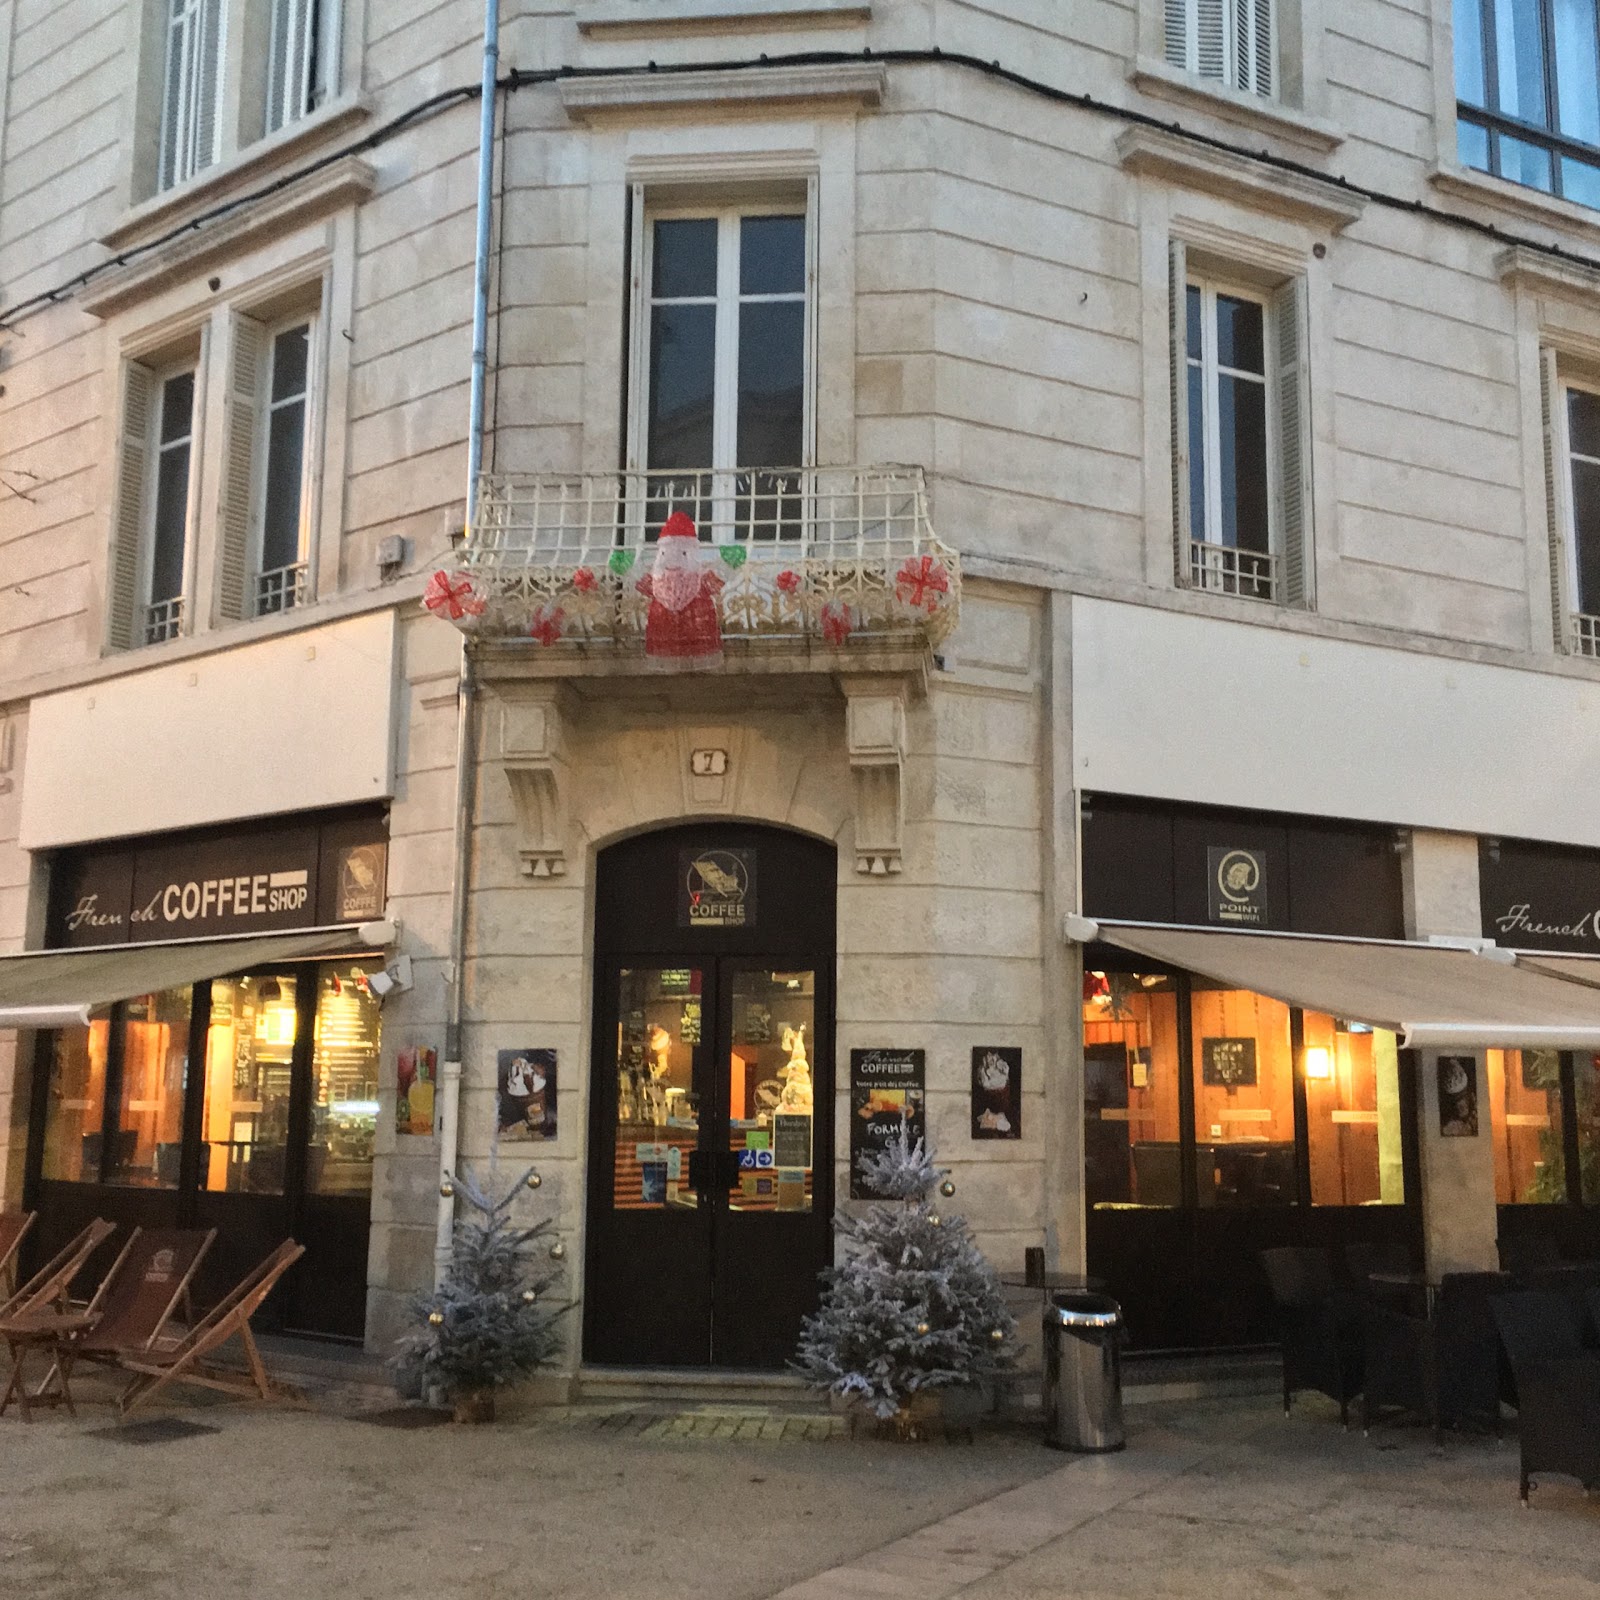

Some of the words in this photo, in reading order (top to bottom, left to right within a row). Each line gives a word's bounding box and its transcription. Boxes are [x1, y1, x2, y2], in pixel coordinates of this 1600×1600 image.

[704, 752, 714, 771] 7
[65, 890, 162, 931] French
[163, 875, 268, 922] COFFEE
[269, 888, 308, 912] SHOP
[689, 904, 745, 917] COFFEE
[1220, 903, 1259, 913] POINT
[1496, 904, 1591, 937] French
[861, 1063, 900, 1074] COFFEE
